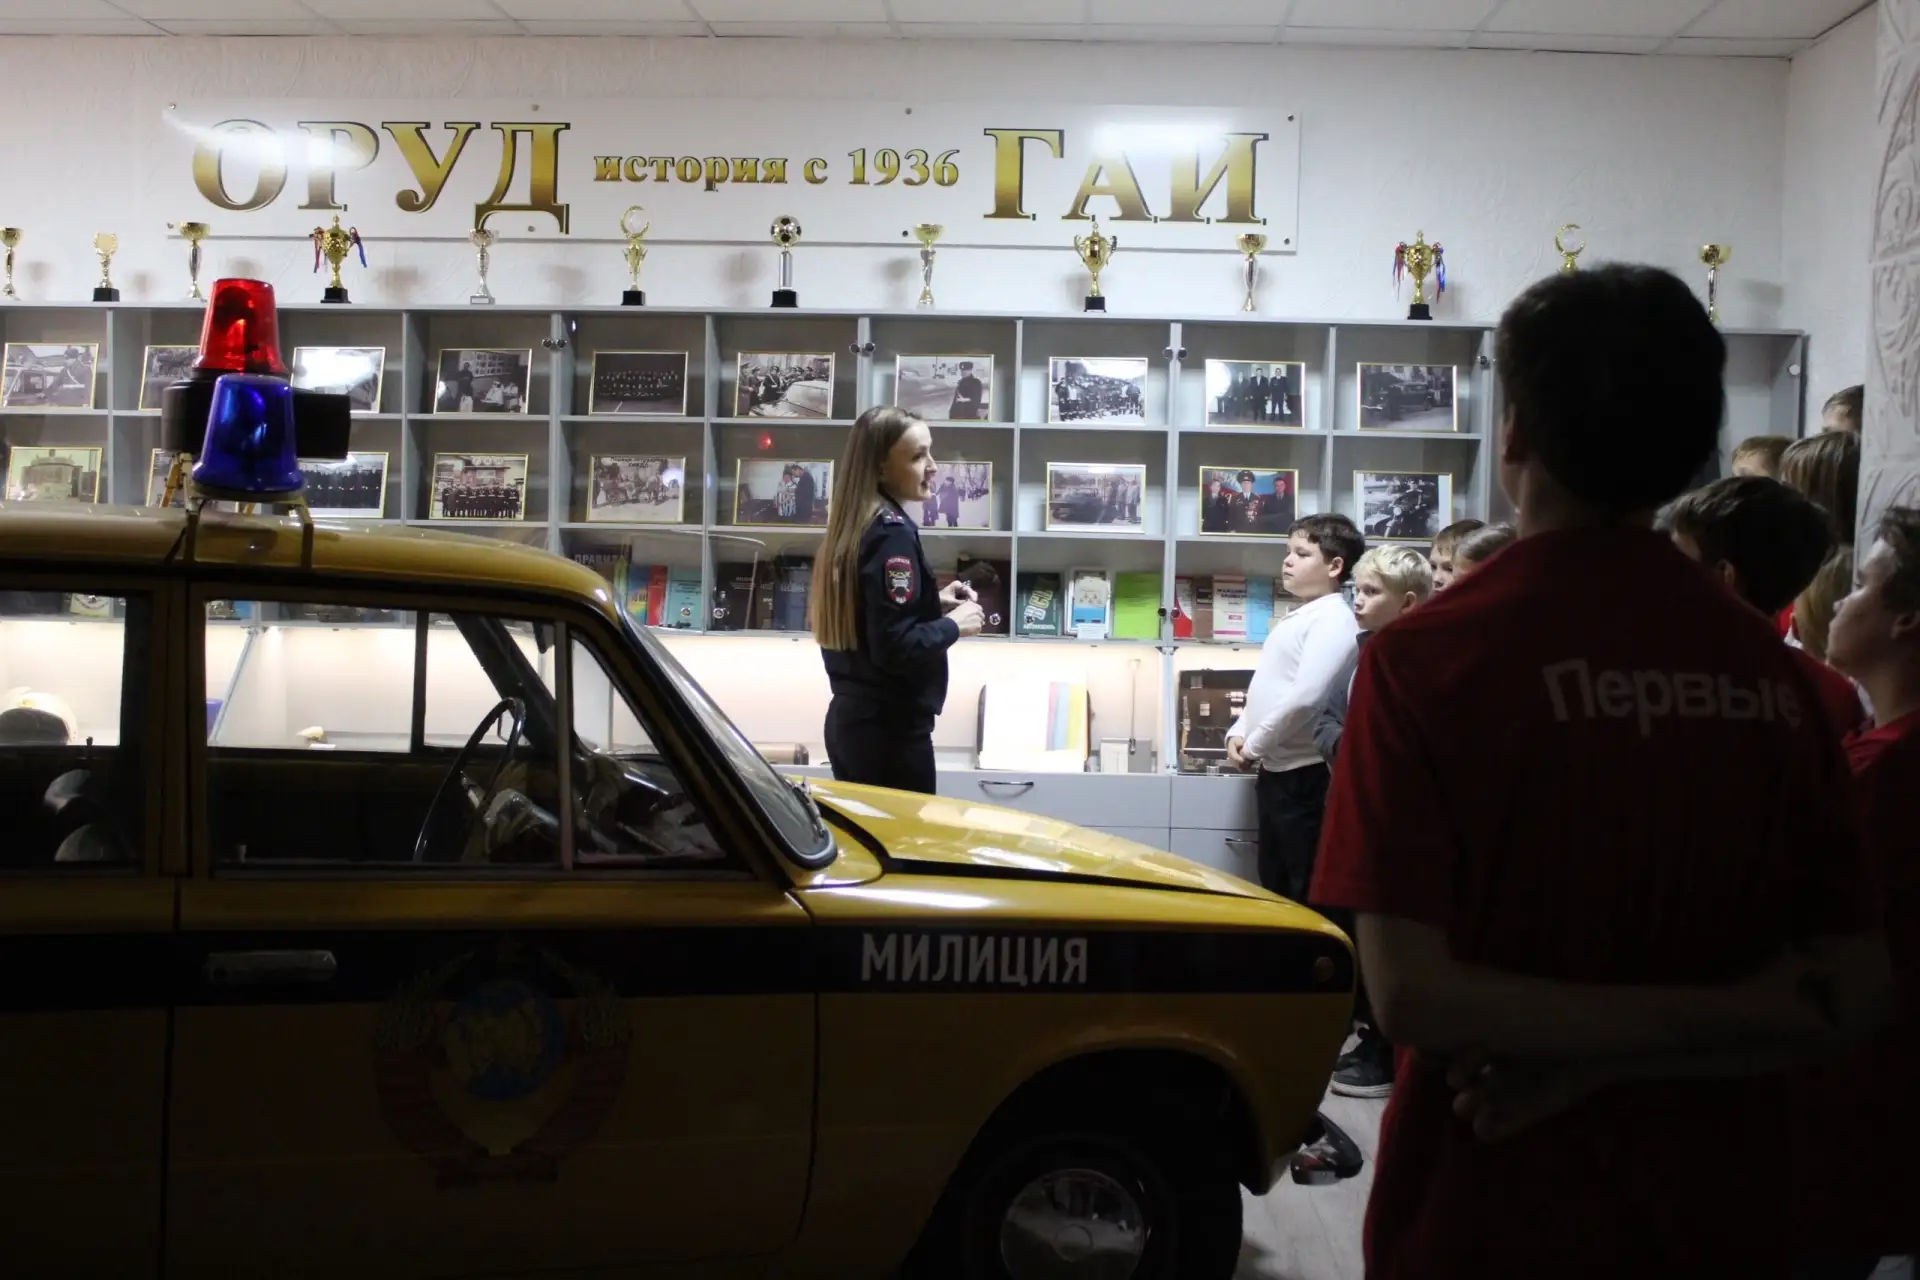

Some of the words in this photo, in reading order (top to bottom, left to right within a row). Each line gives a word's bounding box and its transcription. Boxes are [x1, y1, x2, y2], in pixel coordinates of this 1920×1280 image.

[192, 119, 571, 234] ОРУД
[593, 155, 789, 192] история
[803, 157, 829, 185] с
[847, 148, 961, 187] 1936
[983, 127, 1270, 226] ГАИ
[1541, 657, 1802, 738] Первые
[861, 932, 1088, 987] МИЛИЦИЯ
